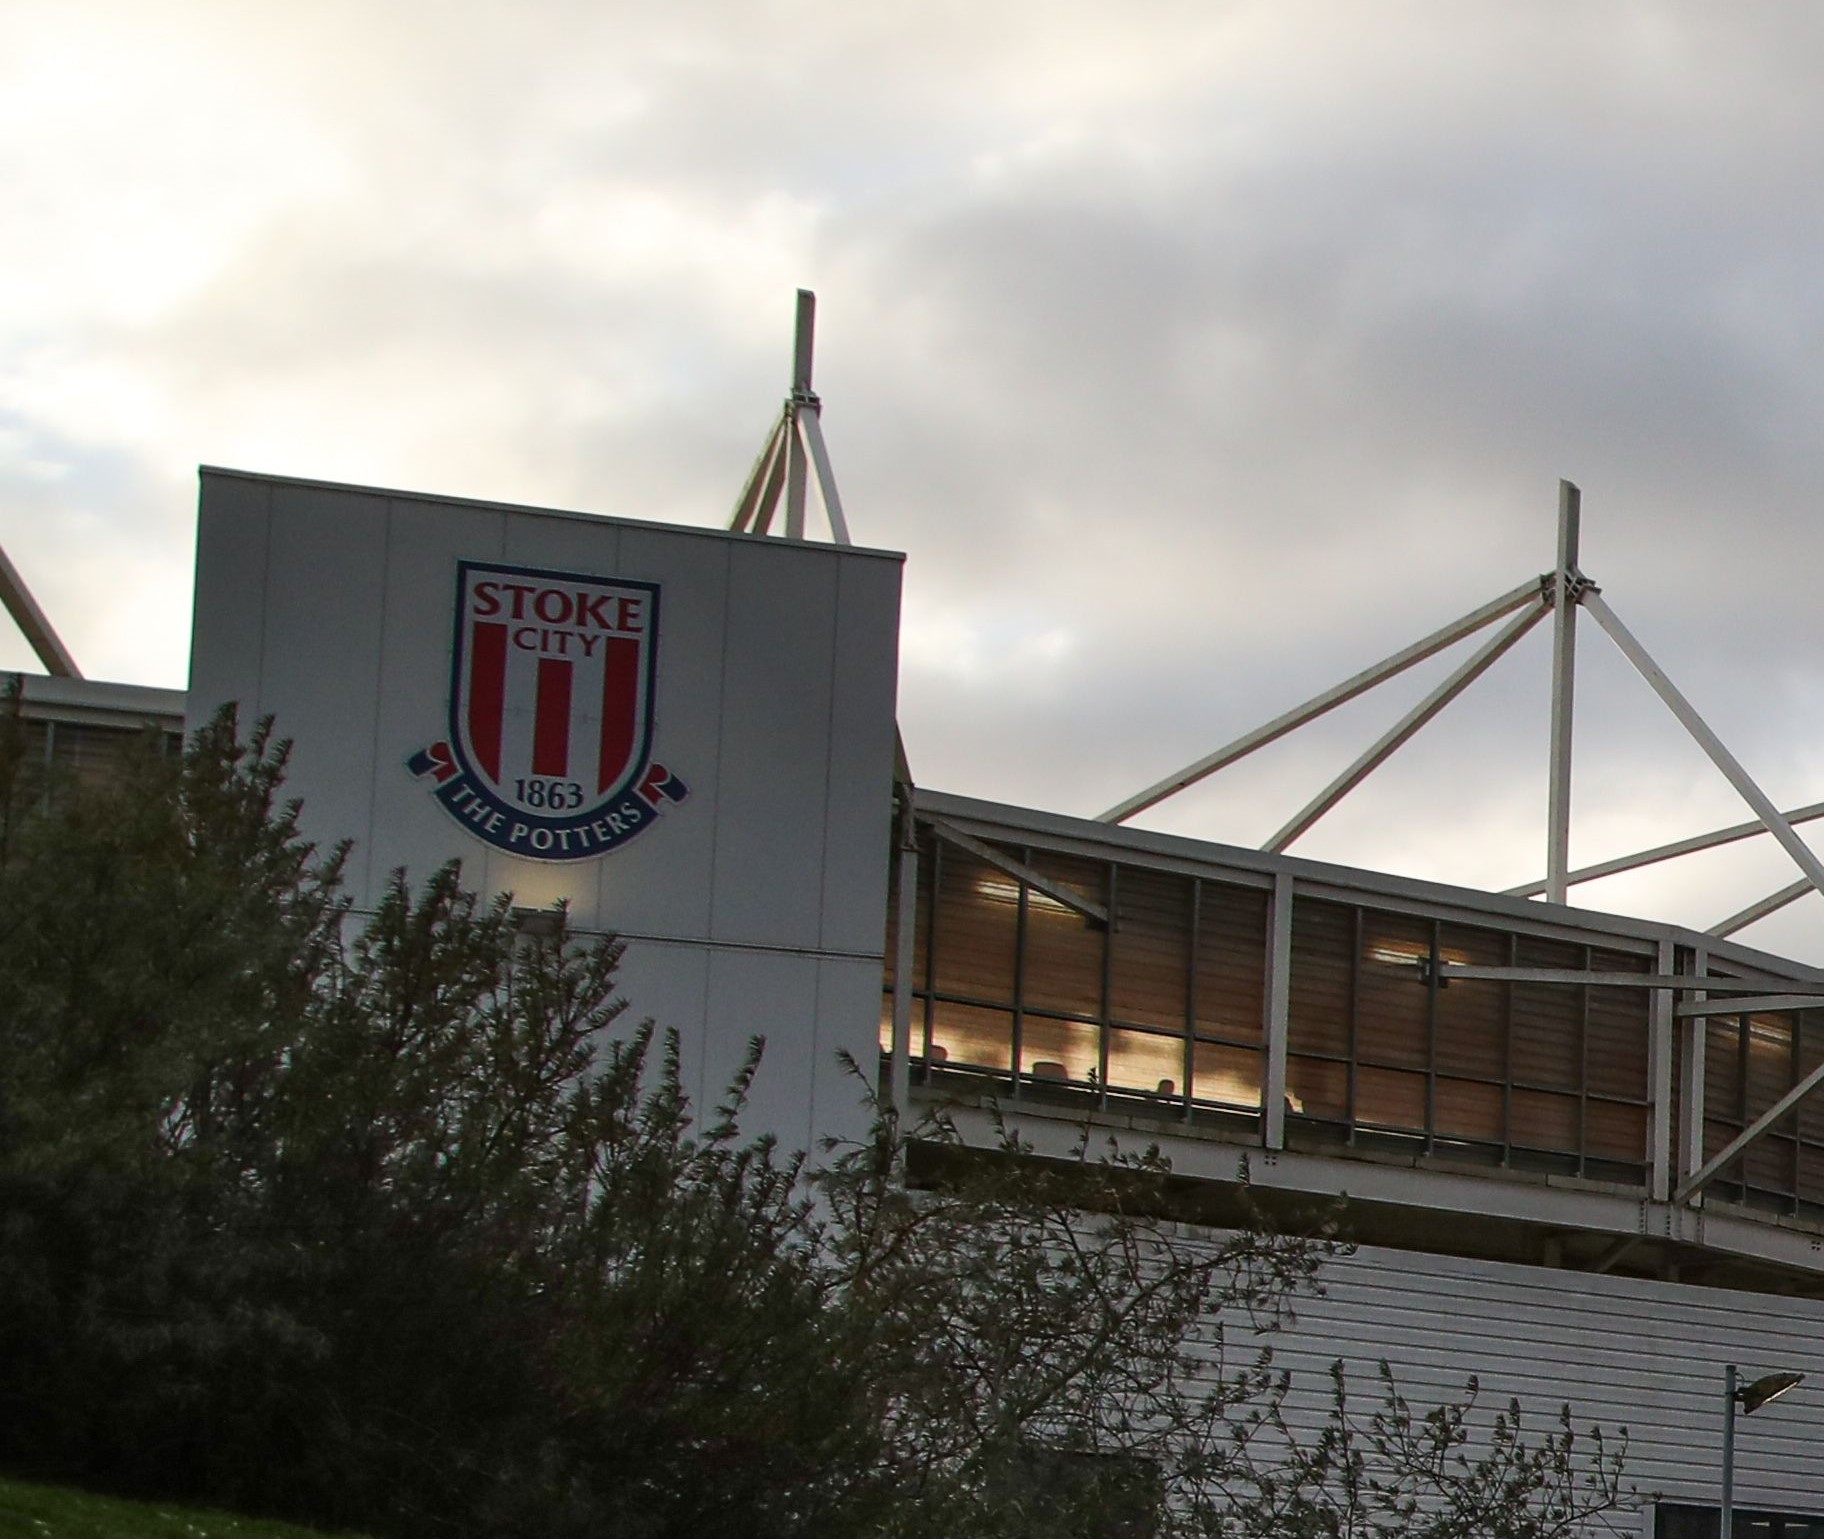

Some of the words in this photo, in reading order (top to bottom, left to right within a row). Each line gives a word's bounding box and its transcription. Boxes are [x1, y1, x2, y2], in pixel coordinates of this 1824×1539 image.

[474, 582, 642, 631] STOKE
[514, 628, 600, 656] CITY
[515, 779, 583, 809] 1863
[451, 784, 507, 834] THE
[509, 802, 641, 850] POTTERS
